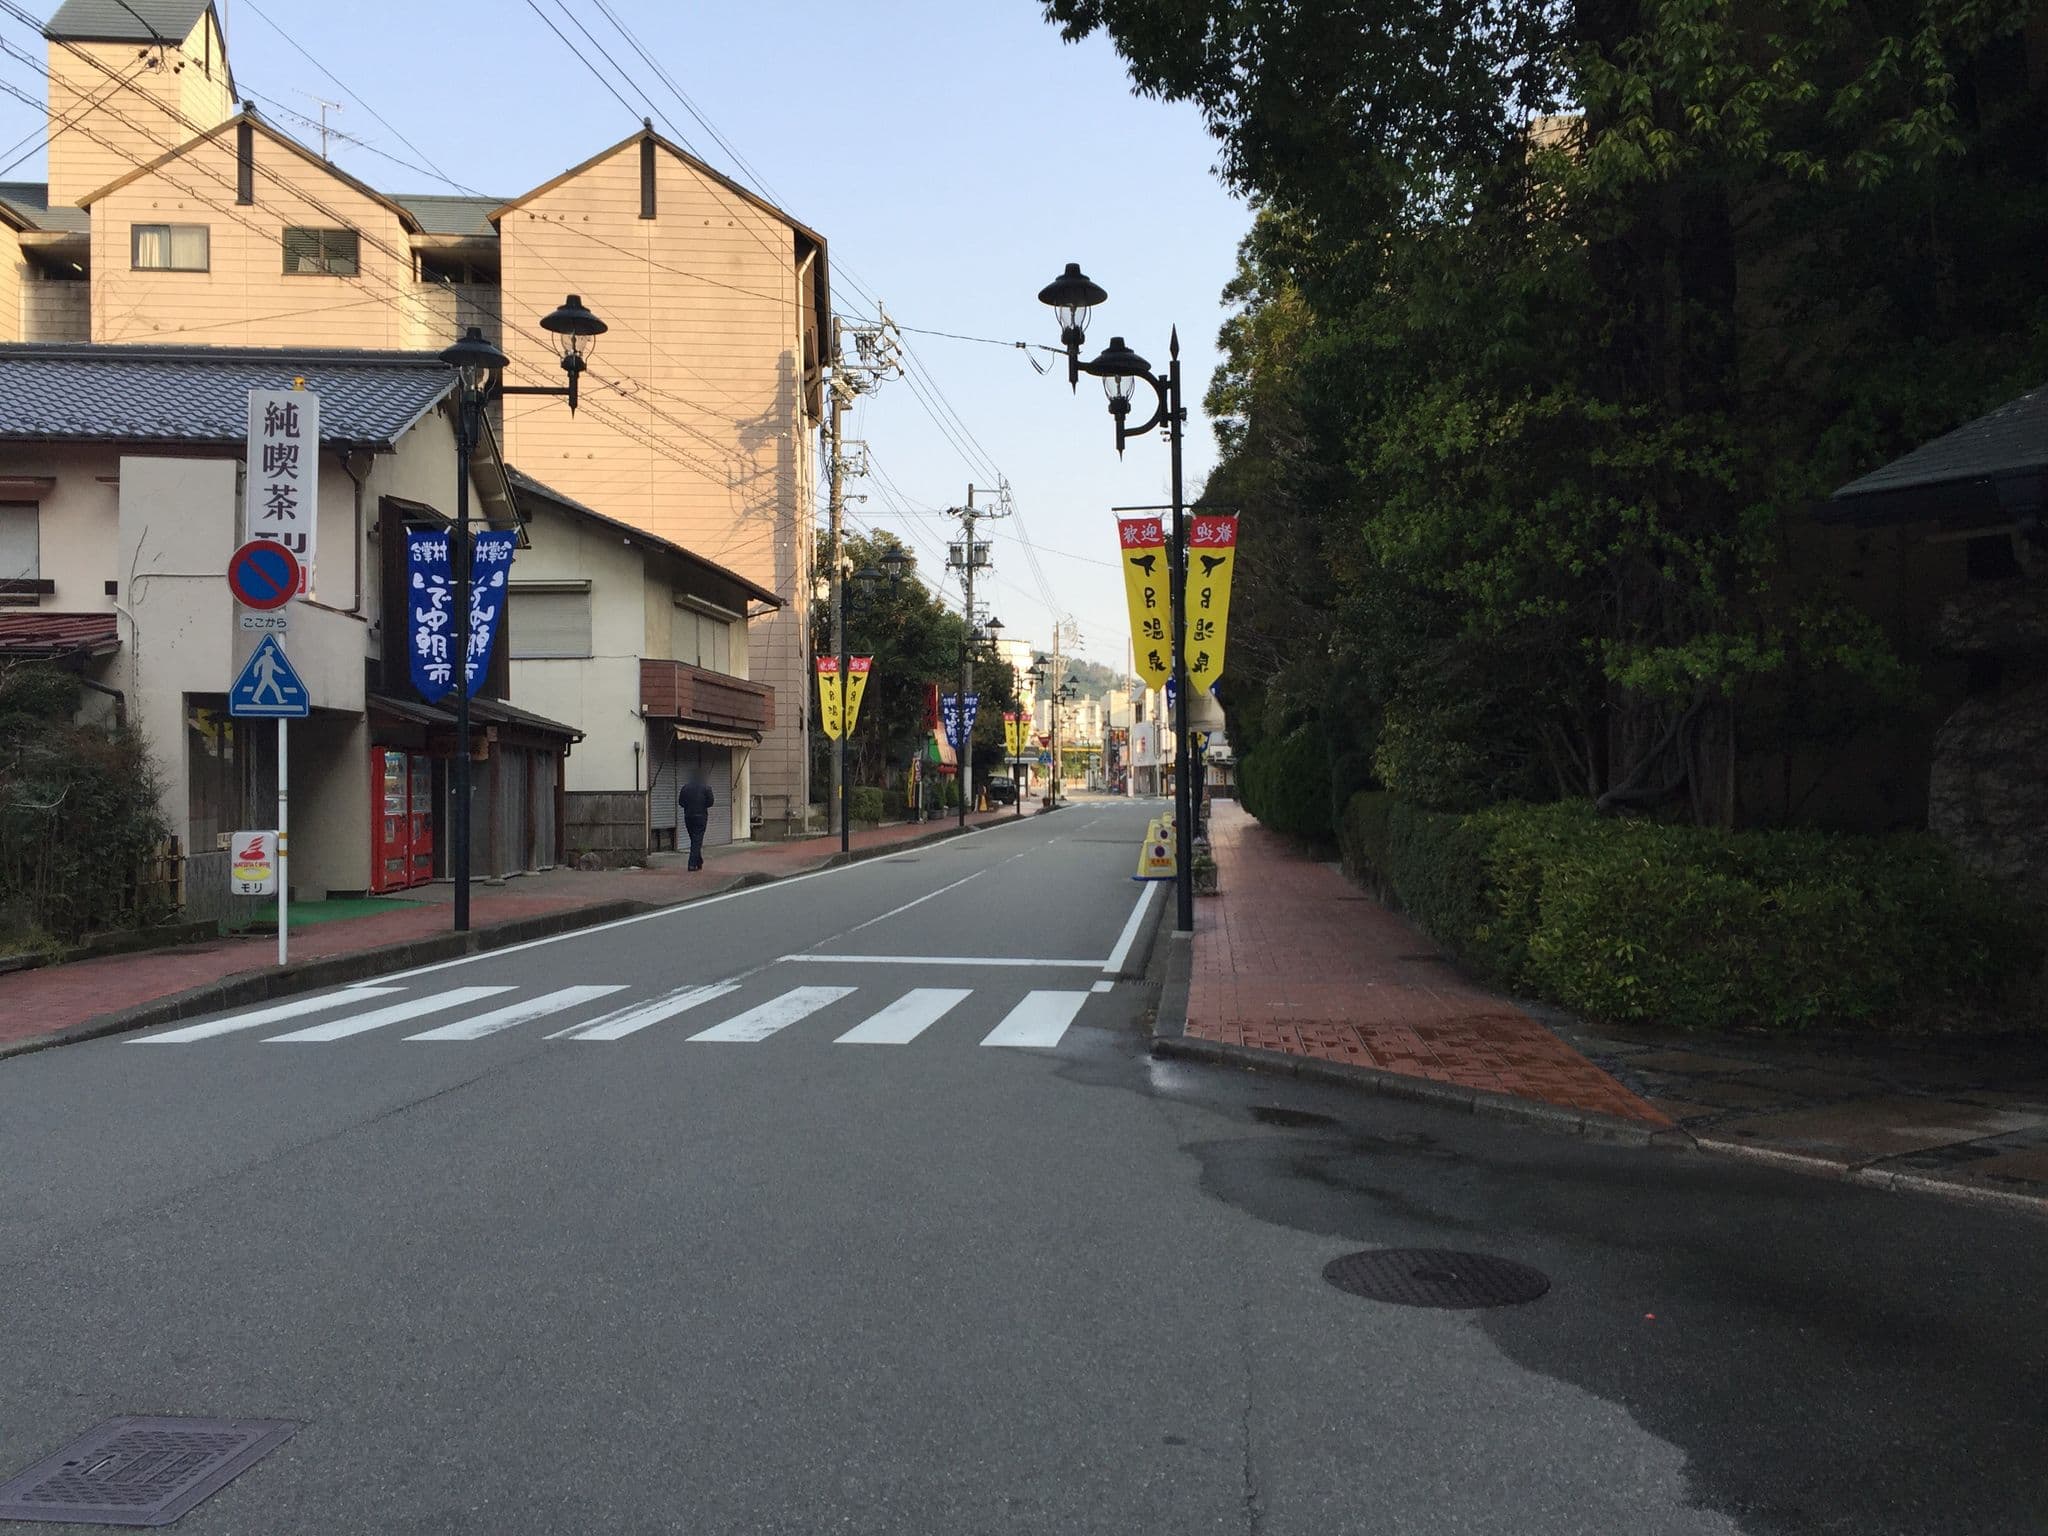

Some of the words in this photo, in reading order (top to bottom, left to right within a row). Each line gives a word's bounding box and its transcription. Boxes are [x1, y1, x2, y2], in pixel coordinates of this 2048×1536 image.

[262, 401, 300, 520] 純喫茶
[1123, 522, 1161, 544] 歓迎
[243, 617, 287, 628] ここから
[240, 882, 263, 893] モリ
